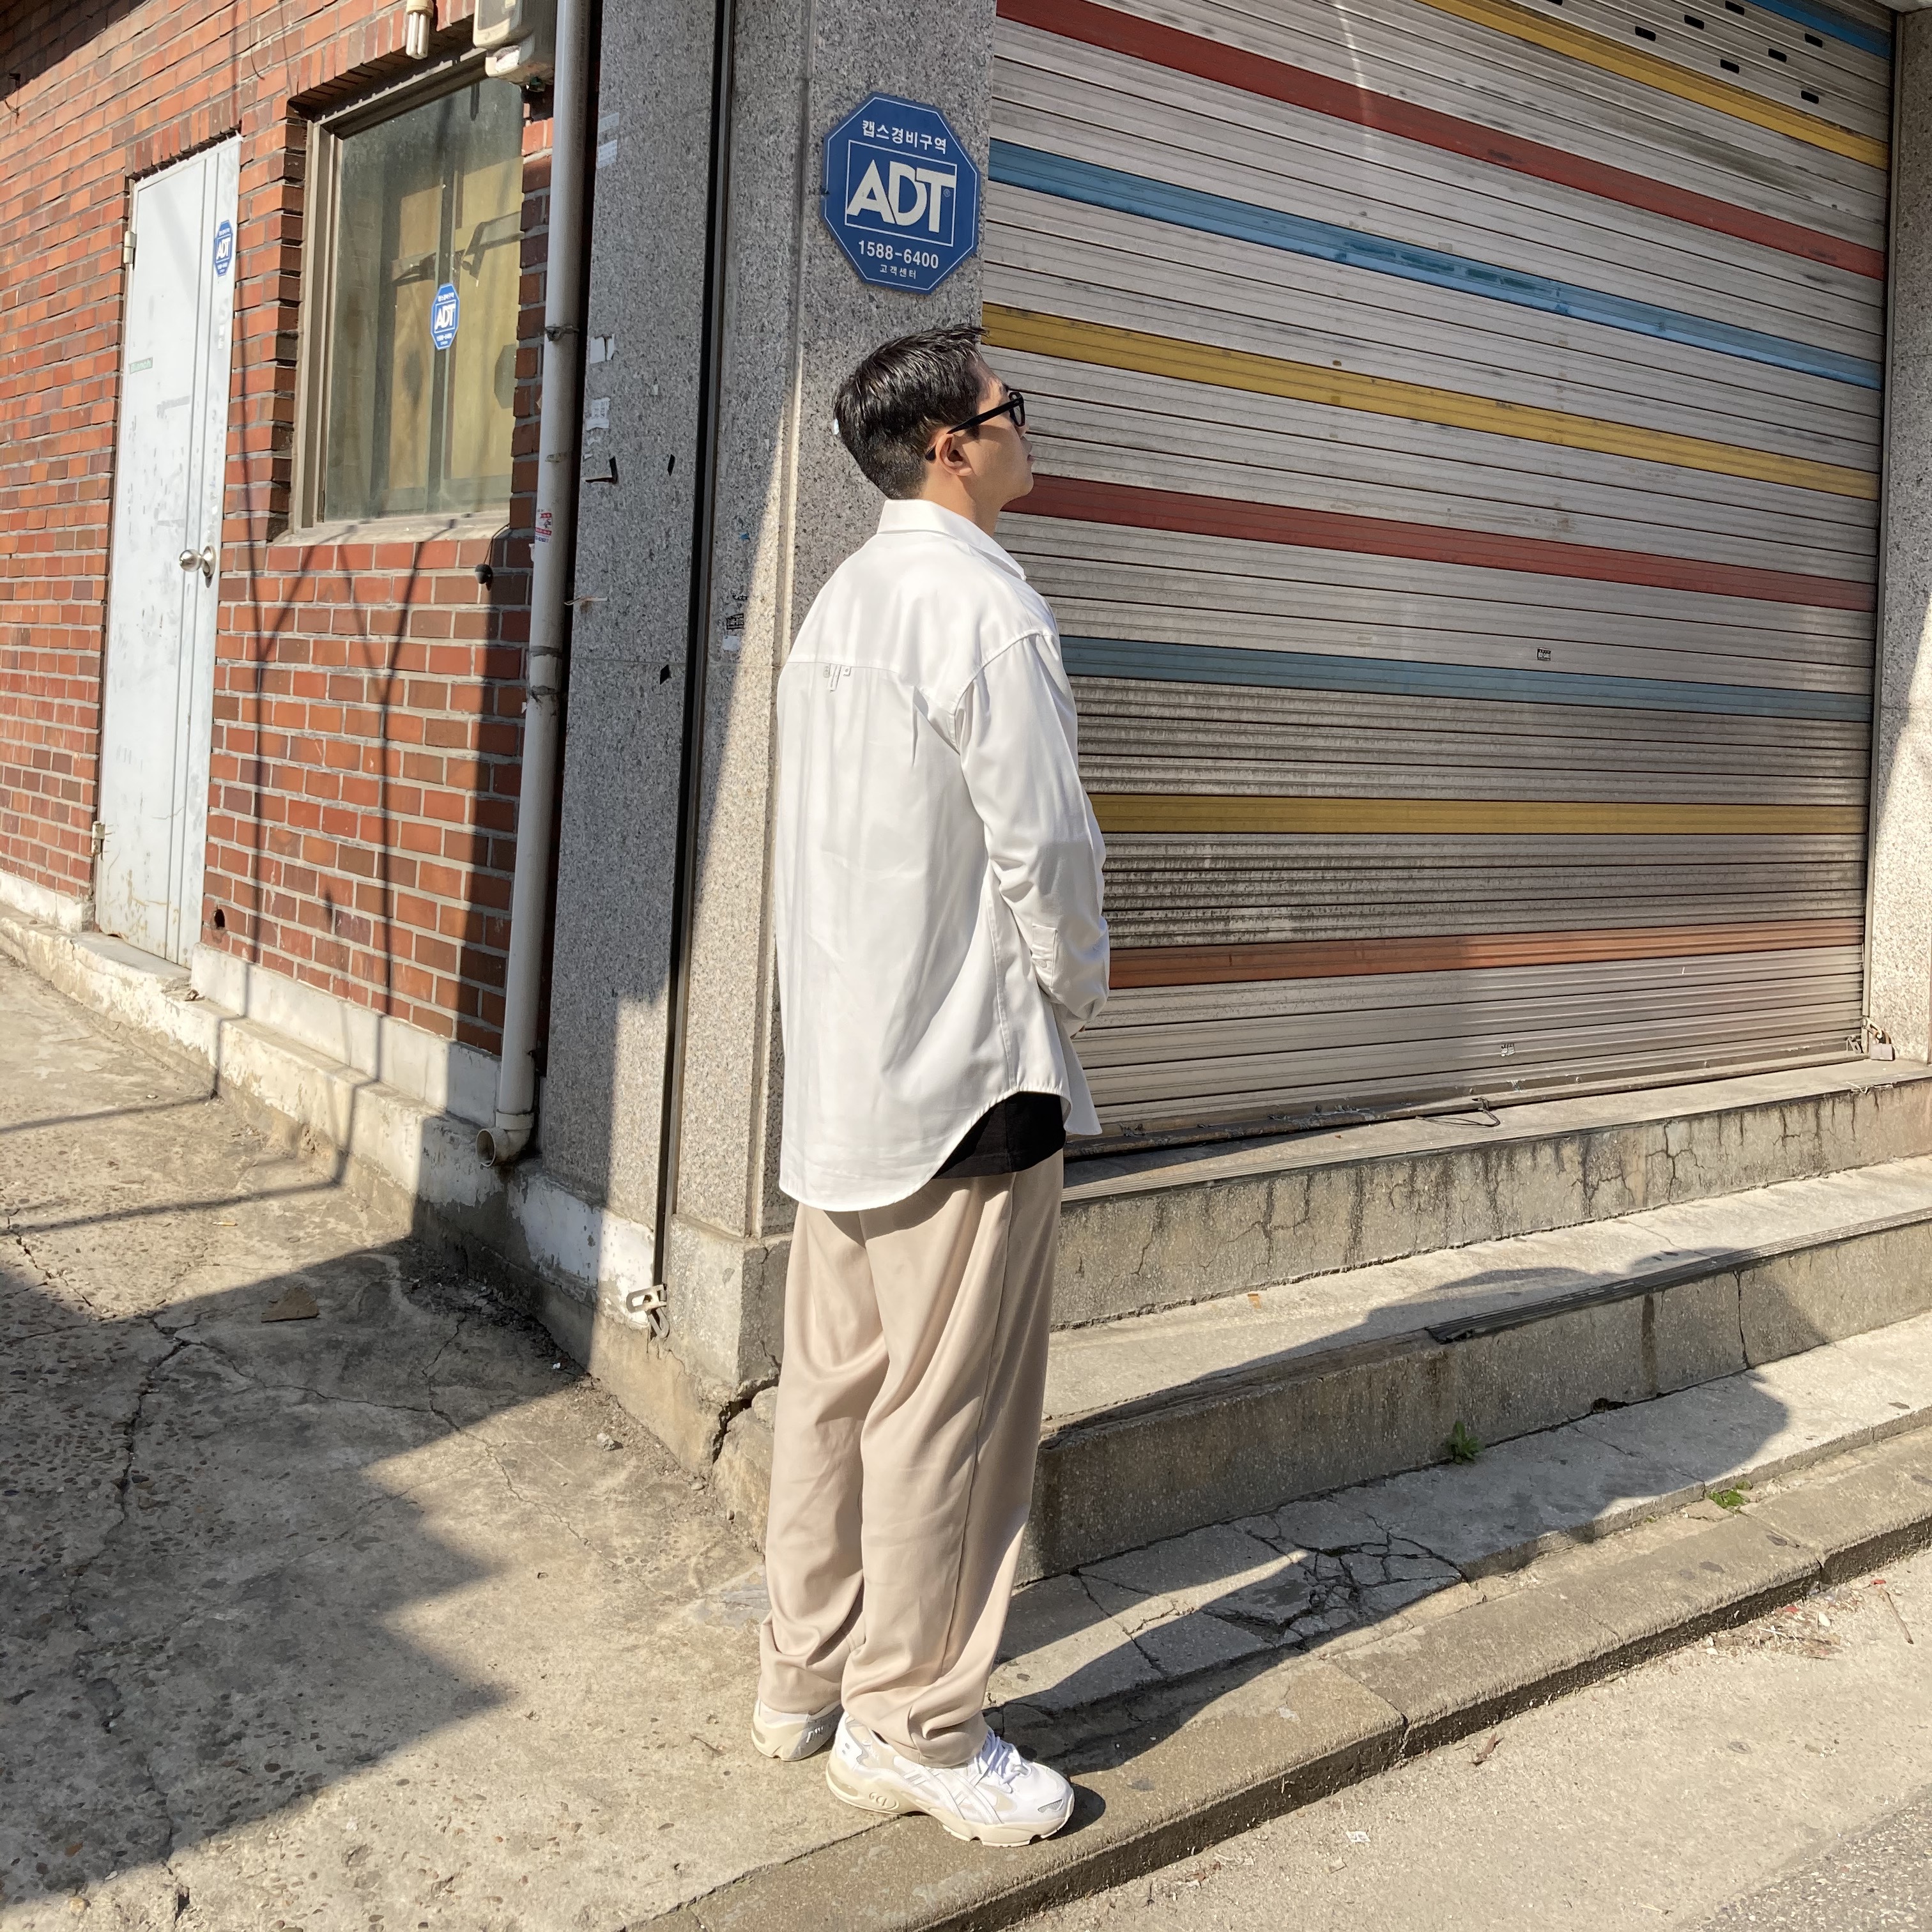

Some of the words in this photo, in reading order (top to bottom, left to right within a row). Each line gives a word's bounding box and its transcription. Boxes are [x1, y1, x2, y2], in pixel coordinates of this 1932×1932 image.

[862, 119, 947, 155] 캡스경비구역
[847, 159, 956, 233] ADT
[216, 237, 231, 261] ADT
[859, 240, 939, 269] 1588-6400
[879, 263, 917, 280] 고객센터
[434, 303, 457, 330] ADT
